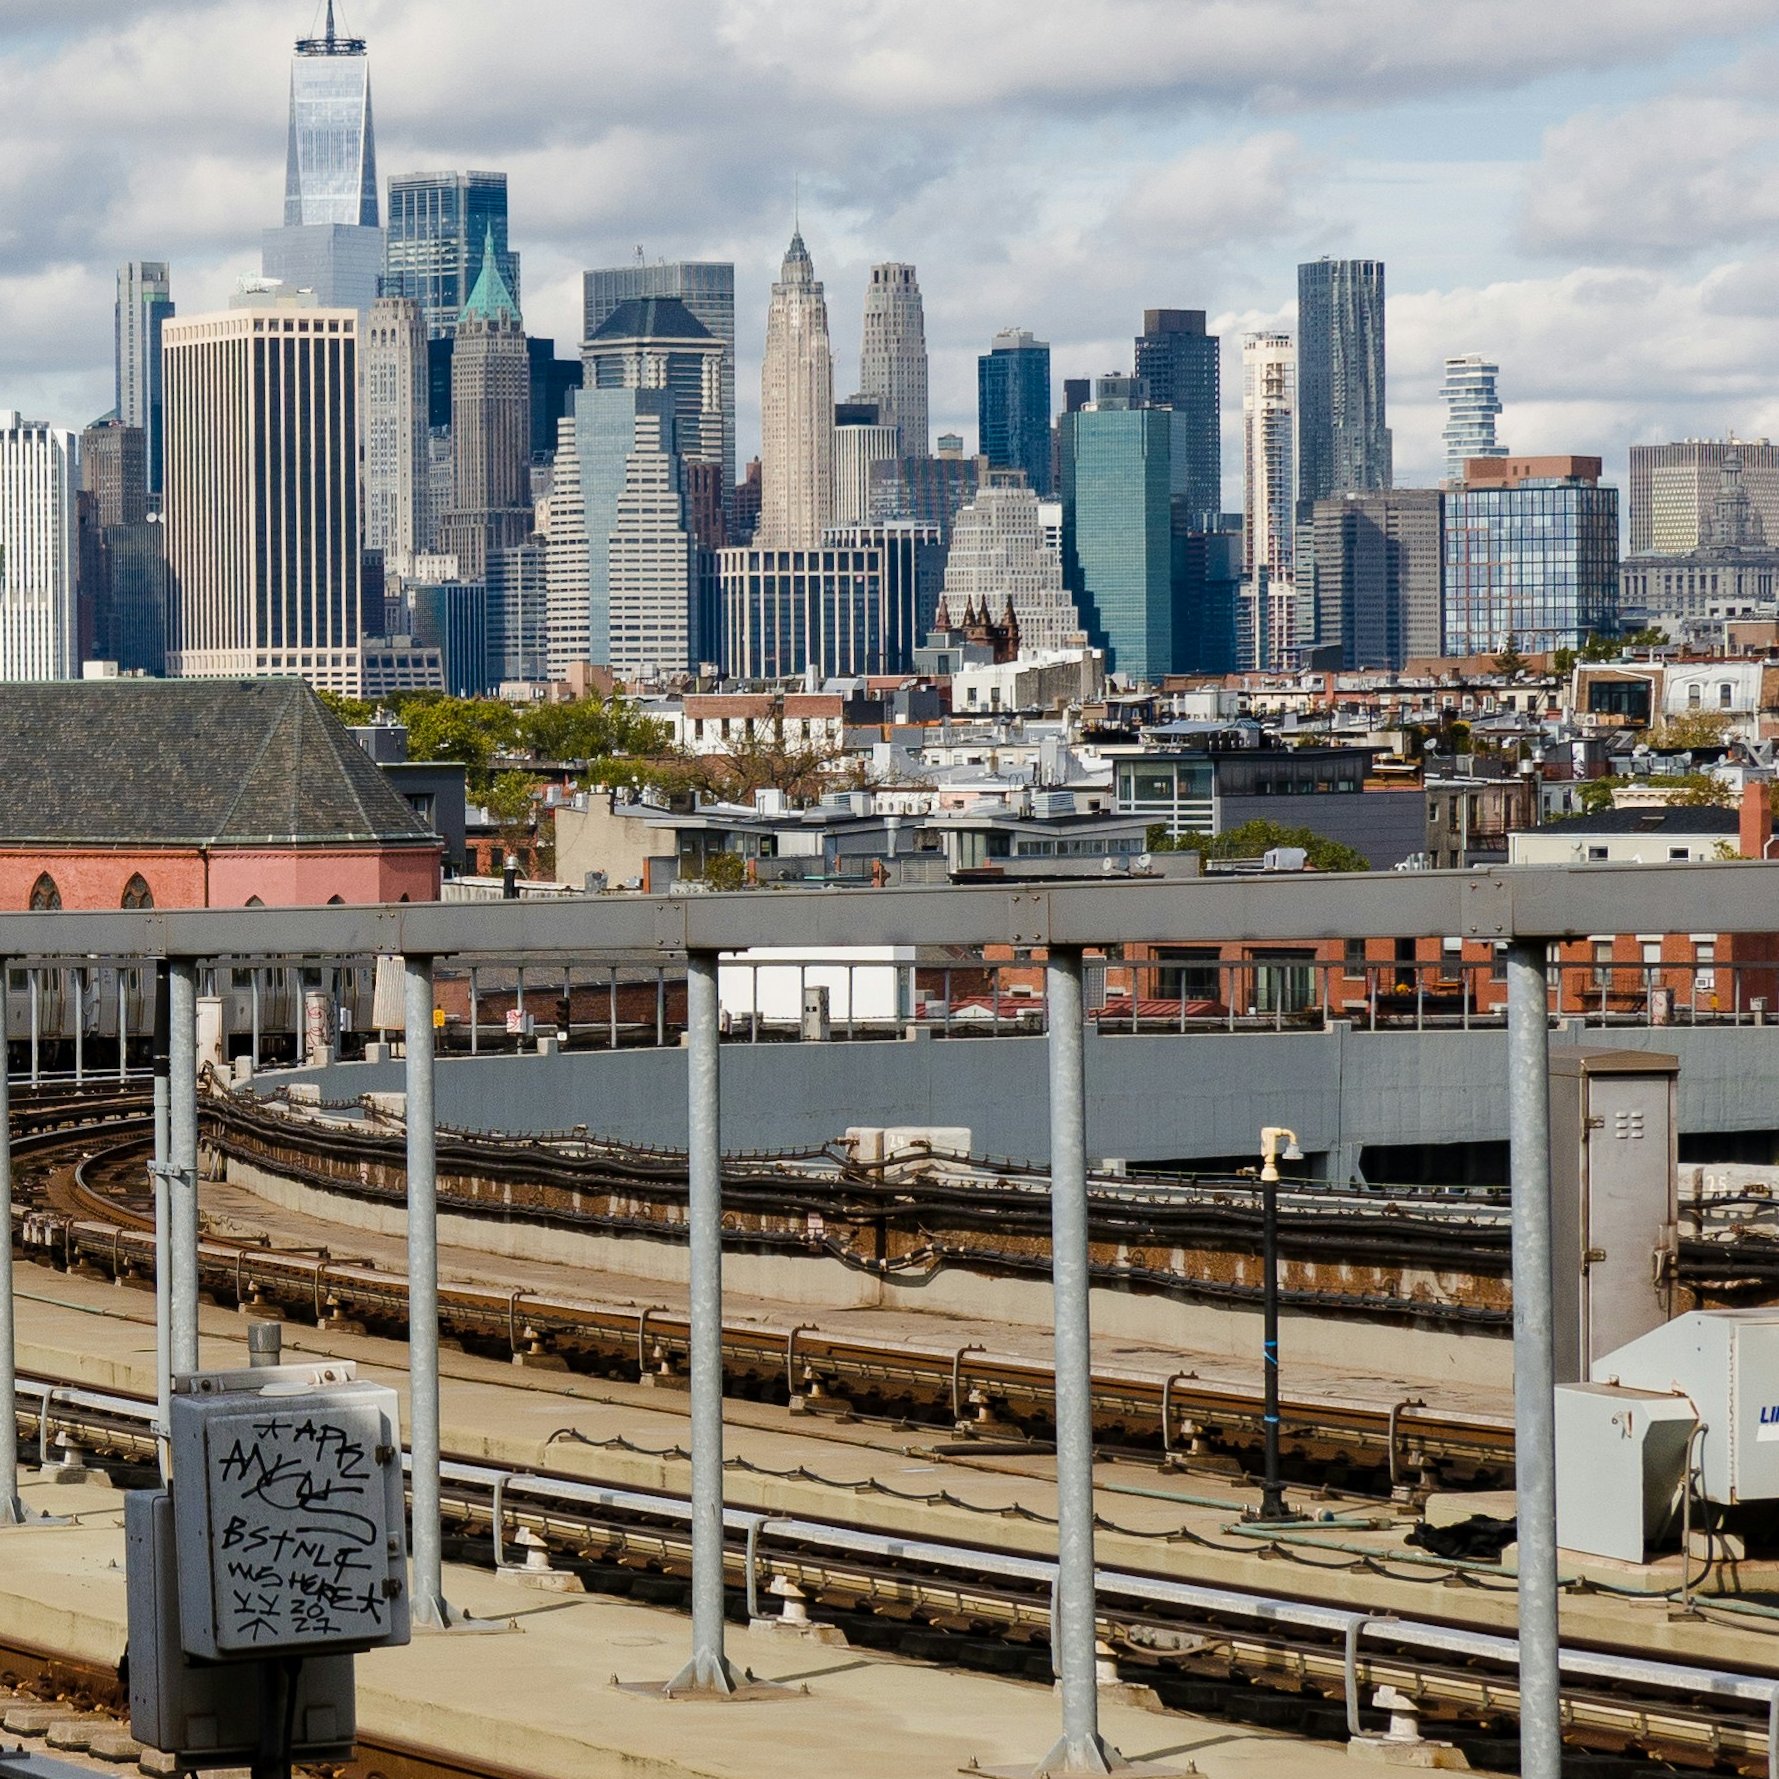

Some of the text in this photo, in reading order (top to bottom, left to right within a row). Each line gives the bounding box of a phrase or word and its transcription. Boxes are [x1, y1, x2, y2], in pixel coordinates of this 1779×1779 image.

[1706, 1175, 1727, 1191] 25
[1760, 1406, 1779, 1424] LI
[288, 1571, 359, 1613] HERE
